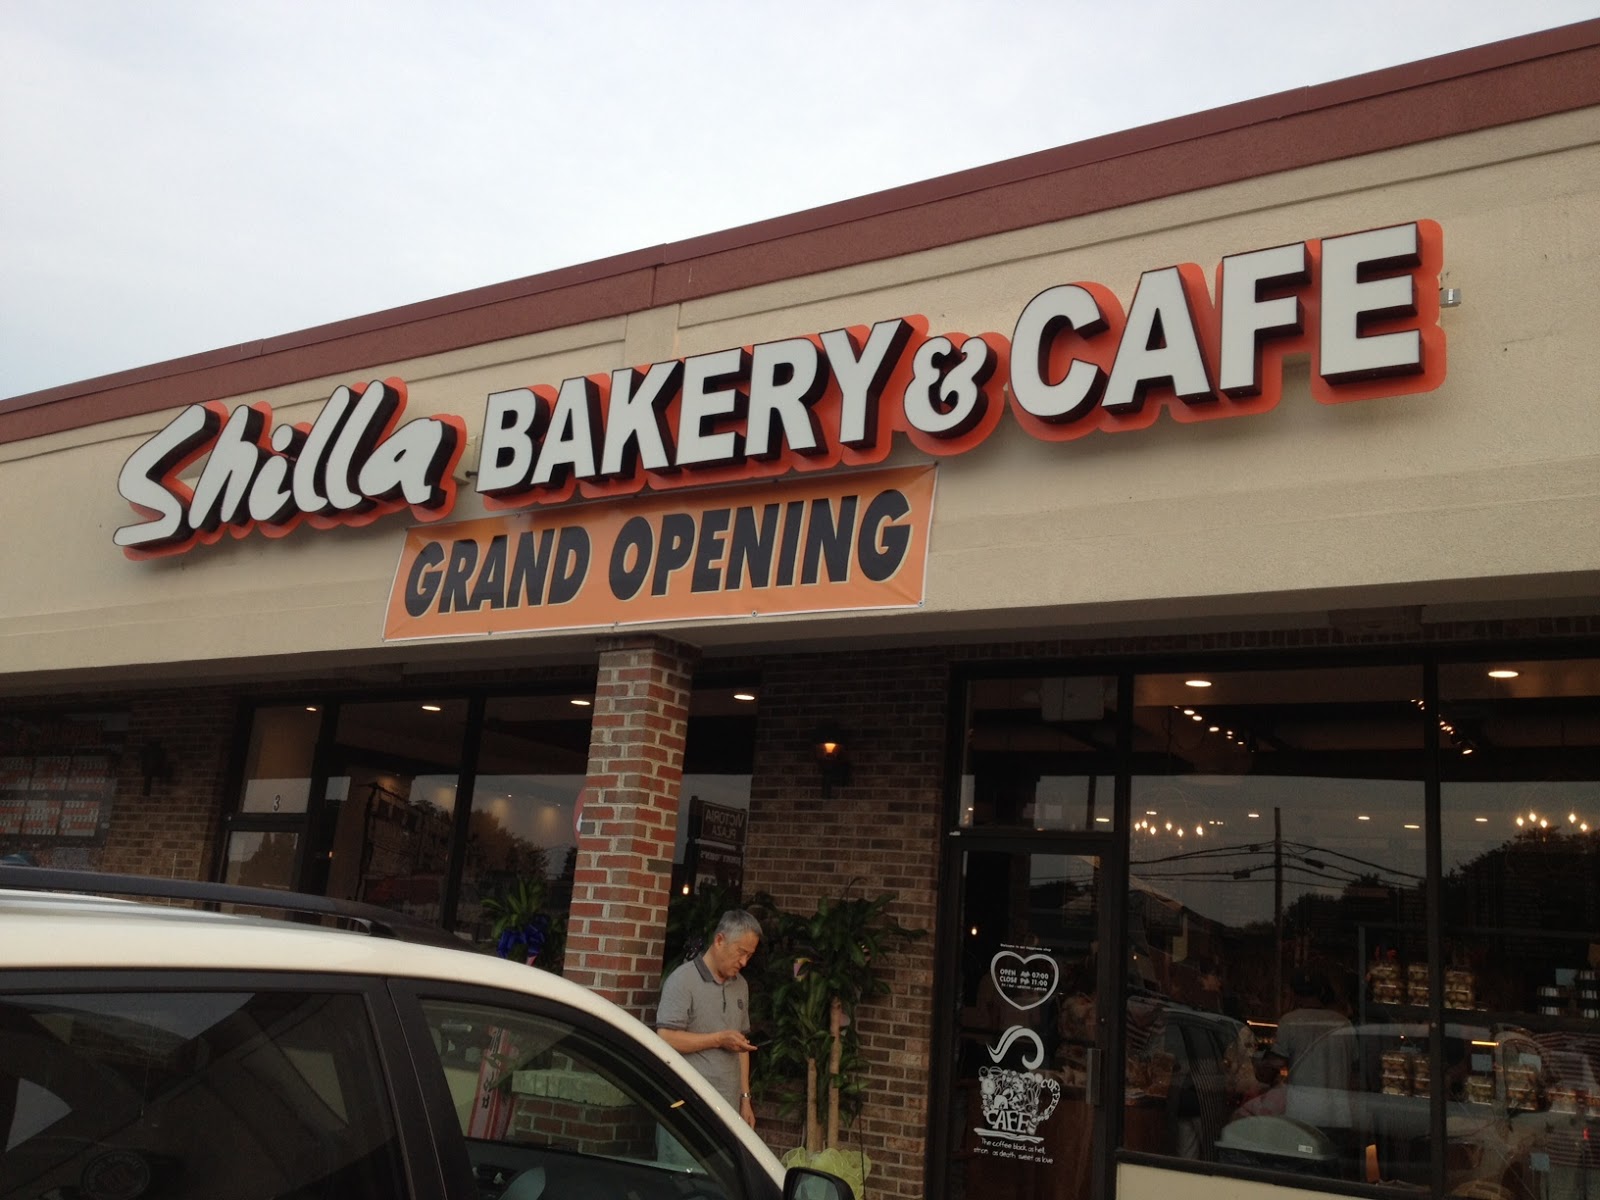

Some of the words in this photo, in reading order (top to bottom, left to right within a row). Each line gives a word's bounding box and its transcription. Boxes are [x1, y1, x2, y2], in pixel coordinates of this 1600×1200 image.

[113, 379, 452, 548] Shilla
[475, 318, 912, 496] BAKERY
[904, 332, 994, 438] &
[1009, 221, 1424, 420] CAFE
[404, 525, 591, 618] GRAND
[608, 488, 912, 602] OPENING
[273, 794, 281, 811] 3
[999, 975, 1017, 983] CLOSE
[1031, 972, 1049, 980] 07:00
[986, 1110, 1032, 1133] CAFE
[992, 1140, 1012, 1149] coffee
